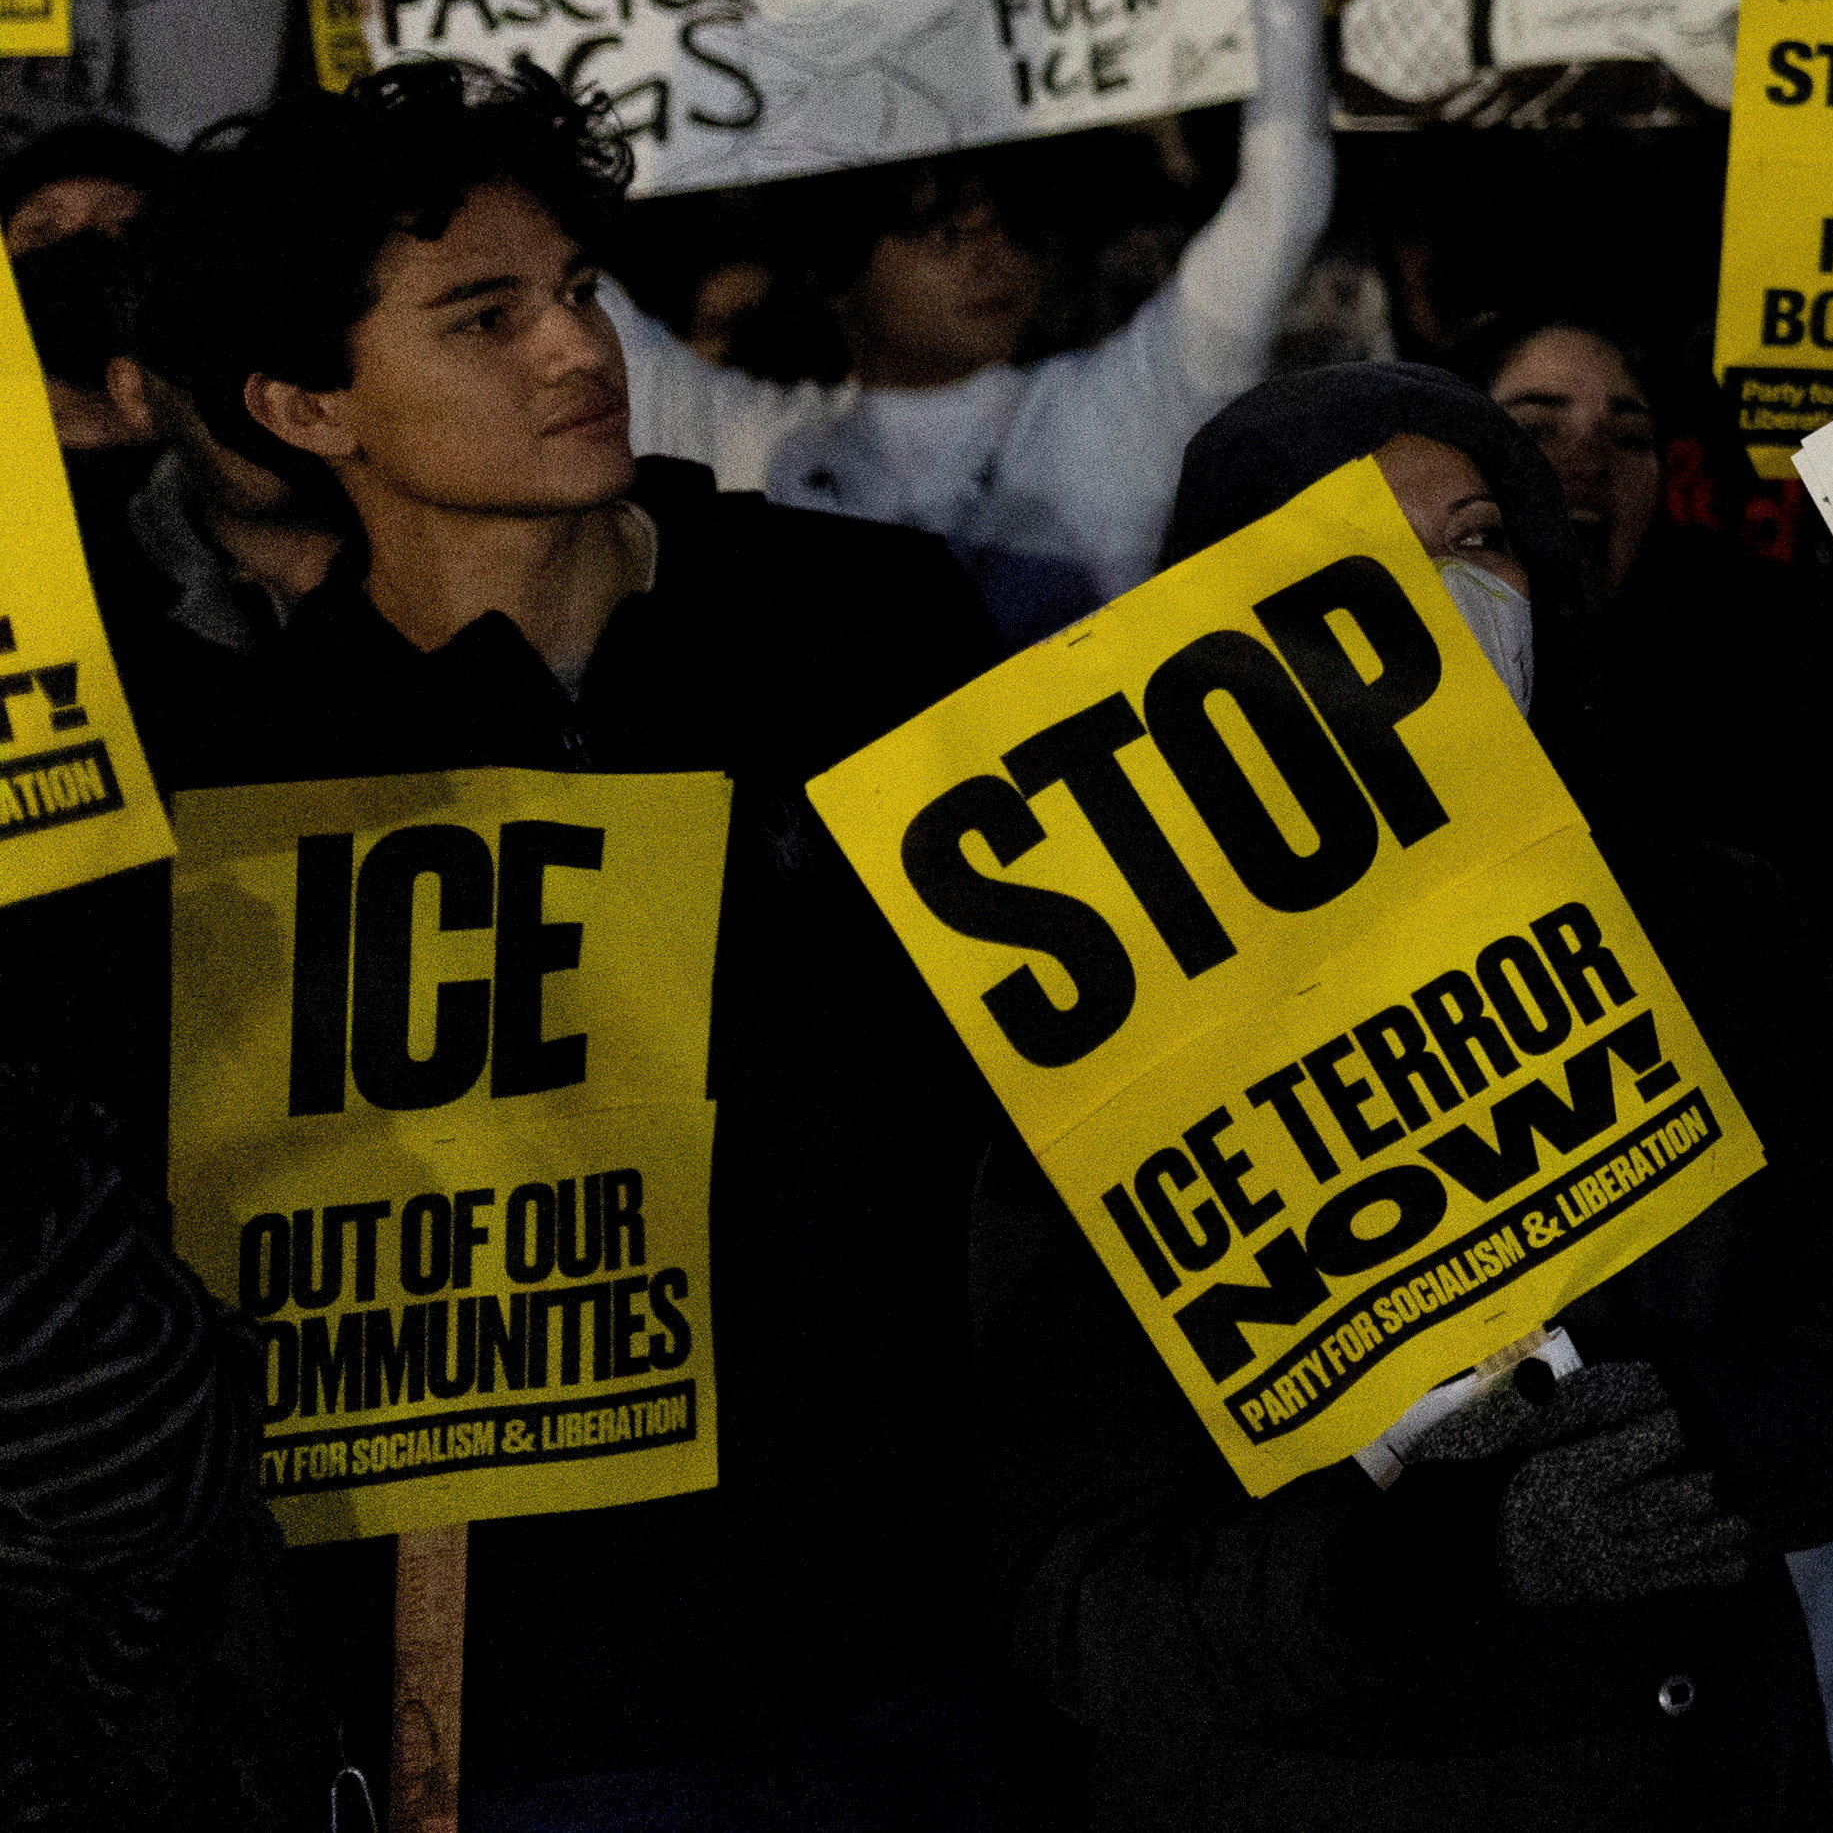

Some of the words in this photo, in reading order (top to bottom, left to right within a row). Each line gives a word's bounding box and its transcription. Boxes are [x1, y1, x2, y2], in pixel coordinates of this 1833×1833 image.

[1011, 33, 1137, 107] ICE
[901, 553, 1450, 1069] STOP
[289, 818, 606, 1118] ICE
[1099, 1109, 1286, 1298] ICE
[1245, 901, 1638, 1178] TERROR
[239, 1199, 392, 1319] OUT
[399, 1188, 496, 1296] OF
[505, 1167, 647, 1284] OUR
[258, 1266, 695, 1425] OMMUNITIES
[1171, 1008, 1680, 1384] NOW!
[1239, 1346, 1327, 1434] PARTY
[1324, 1312, 1384, 1368] FOR
[1373, 1225, 1527, 1333] SOCIALISM
[1521, 1211, 1567, 1251] &
[1555, 1105, 1710, 1228] LIBERATION
[293, 1442, 348, 1484] FOR
[352, 1420, 496, 1475] SOCIALISM
[501, 1418, 537, 1455] &
[541, 1395, 689, 1452] LIBERATION
